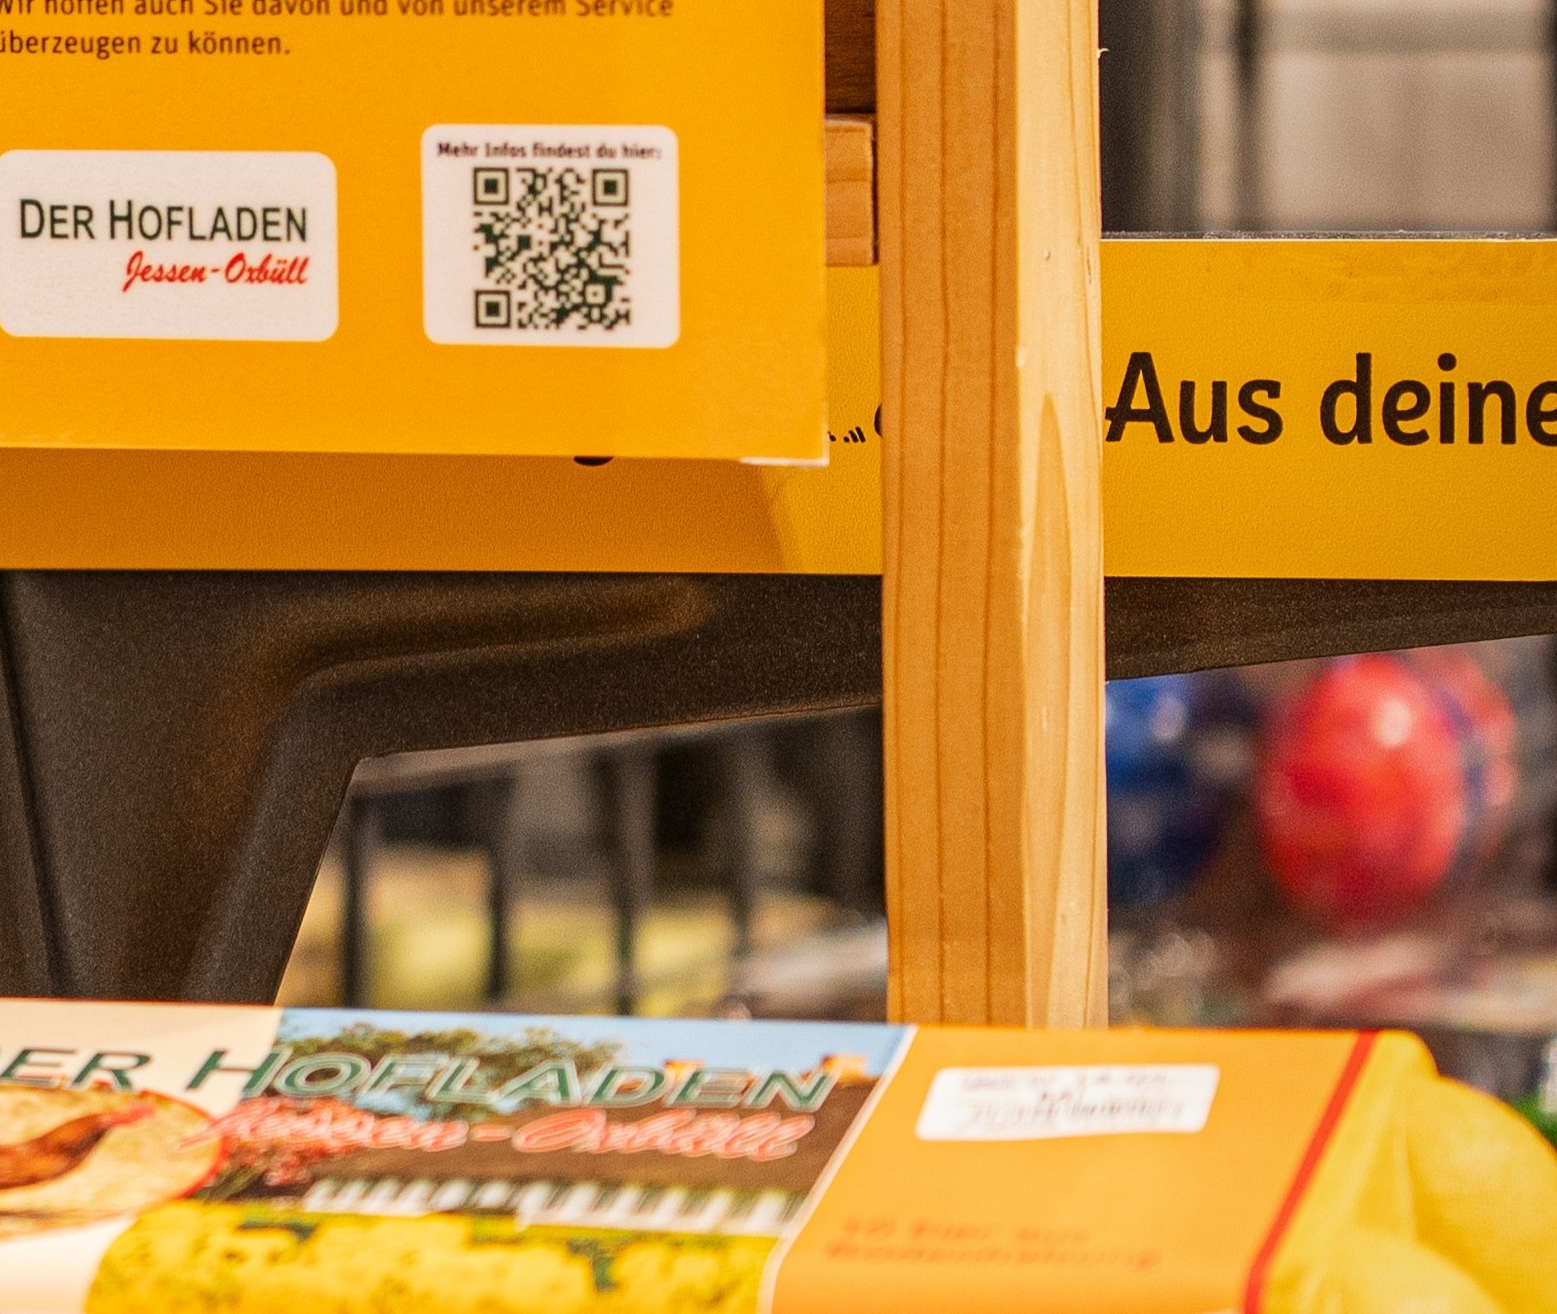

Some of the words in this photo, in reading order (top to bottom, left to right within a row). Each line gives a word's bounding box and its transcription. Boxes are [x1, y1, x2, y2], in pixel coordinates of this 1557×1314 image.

[150, 35, 179, 55] zu
[187, 30, 290, 56] können.
[437, 142, 478, 158] Mehr
[484, 142, 527, 158] Infos
[532, 142, 591, 159] findest
[596, 143, 616, 159] du
[19, 197, 96, 240] DER
[108, 199, 308, 242] HOFLADEN
[122, 250, 310, 293] Jessen-Oxbüll
[1105, 352, 1282, 444] Aus
[186, 1047, 840, 1112] HOFLADEN
